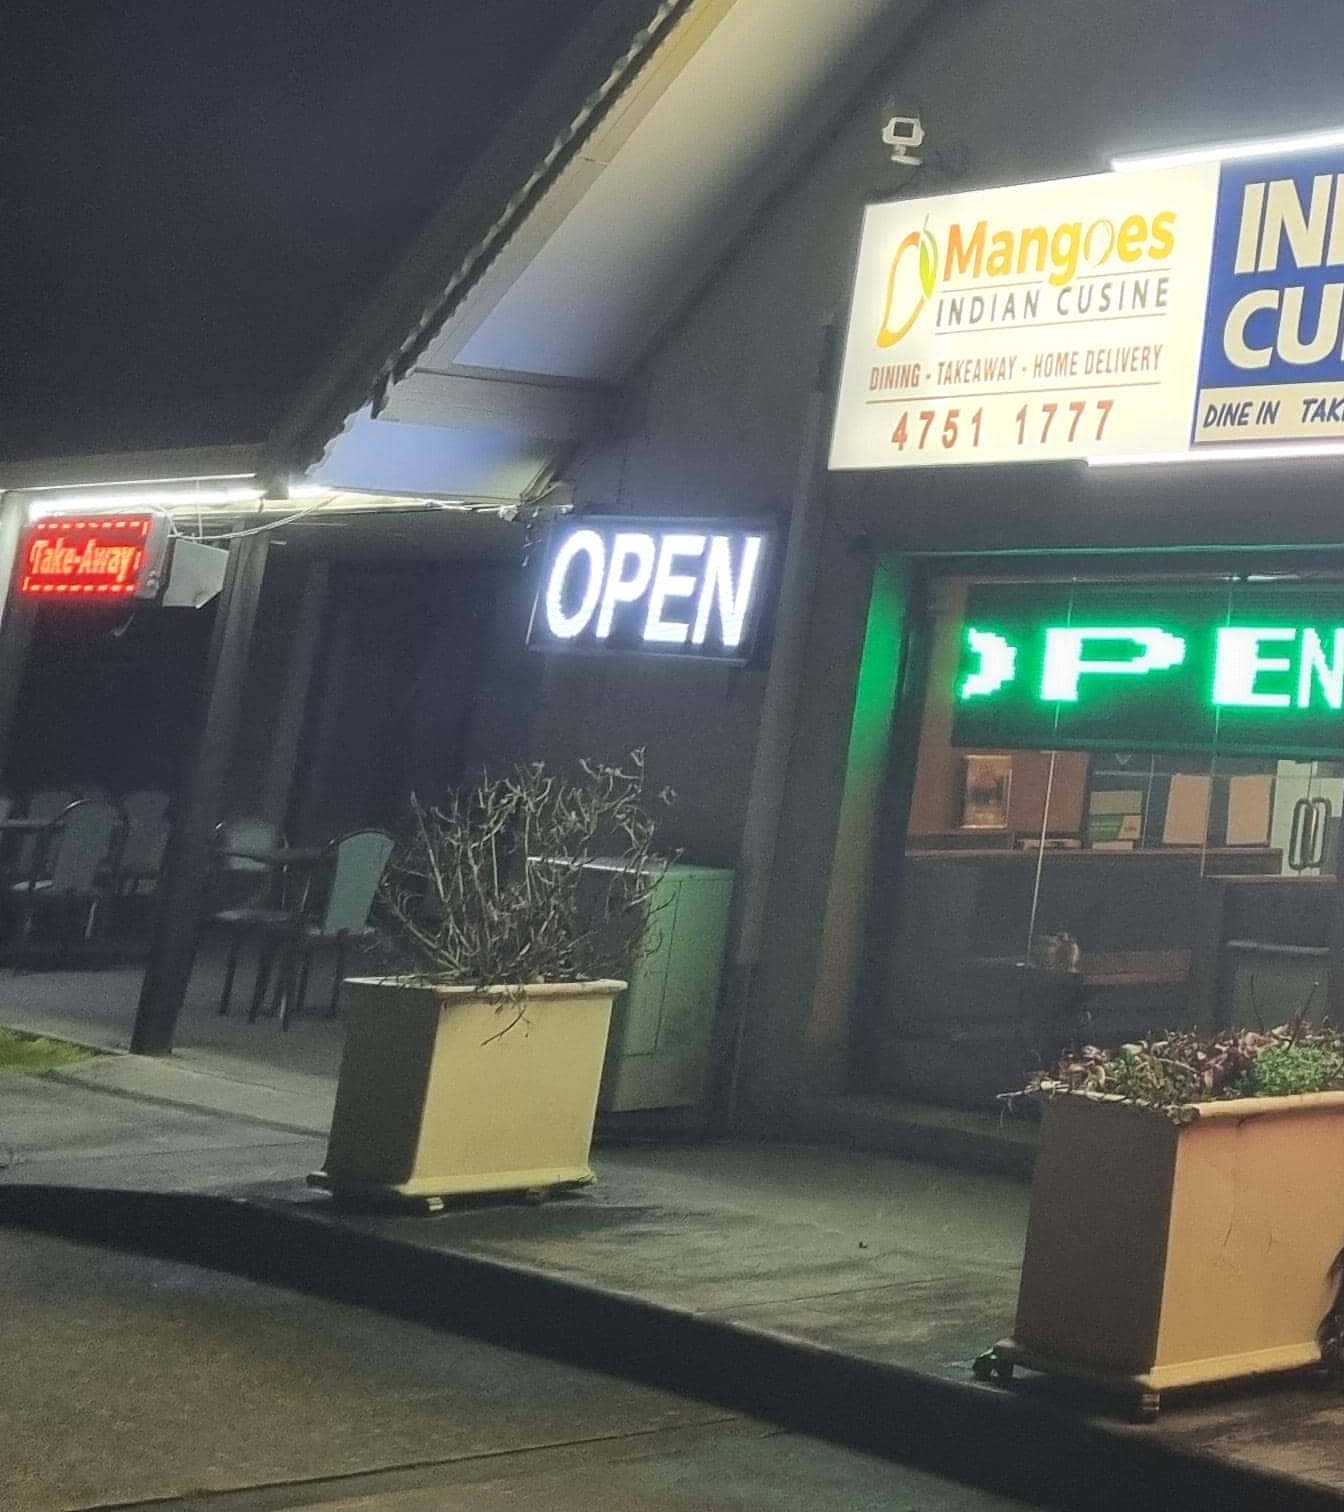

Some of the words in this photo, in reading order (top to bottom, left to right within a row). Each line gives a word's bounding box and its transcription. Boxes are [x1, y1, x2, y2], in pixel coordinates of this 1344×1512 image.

[943, 211, 1177, 285] Mangoes
[936, 290, 1040, 327] INDIAN
[1056, 277, 1170, 315] CUSINE
[869, 363, 921, 391] DINING
[937, 356, 1017, 386] TAKEAWAY
[1033, 351, 1080, 378] HOME
[1084, 344, 1163, 375] DELIVERY
[891, 407, 983, 451] 4751
[1016, 399, 1114, 445] 1777
[1203, 401, 1252, 428] DINE
[1256, 400, 1280, 425] IN
[29, 538, 136, 582] Take-Away
[545, 529, 763, 647] OPEN
